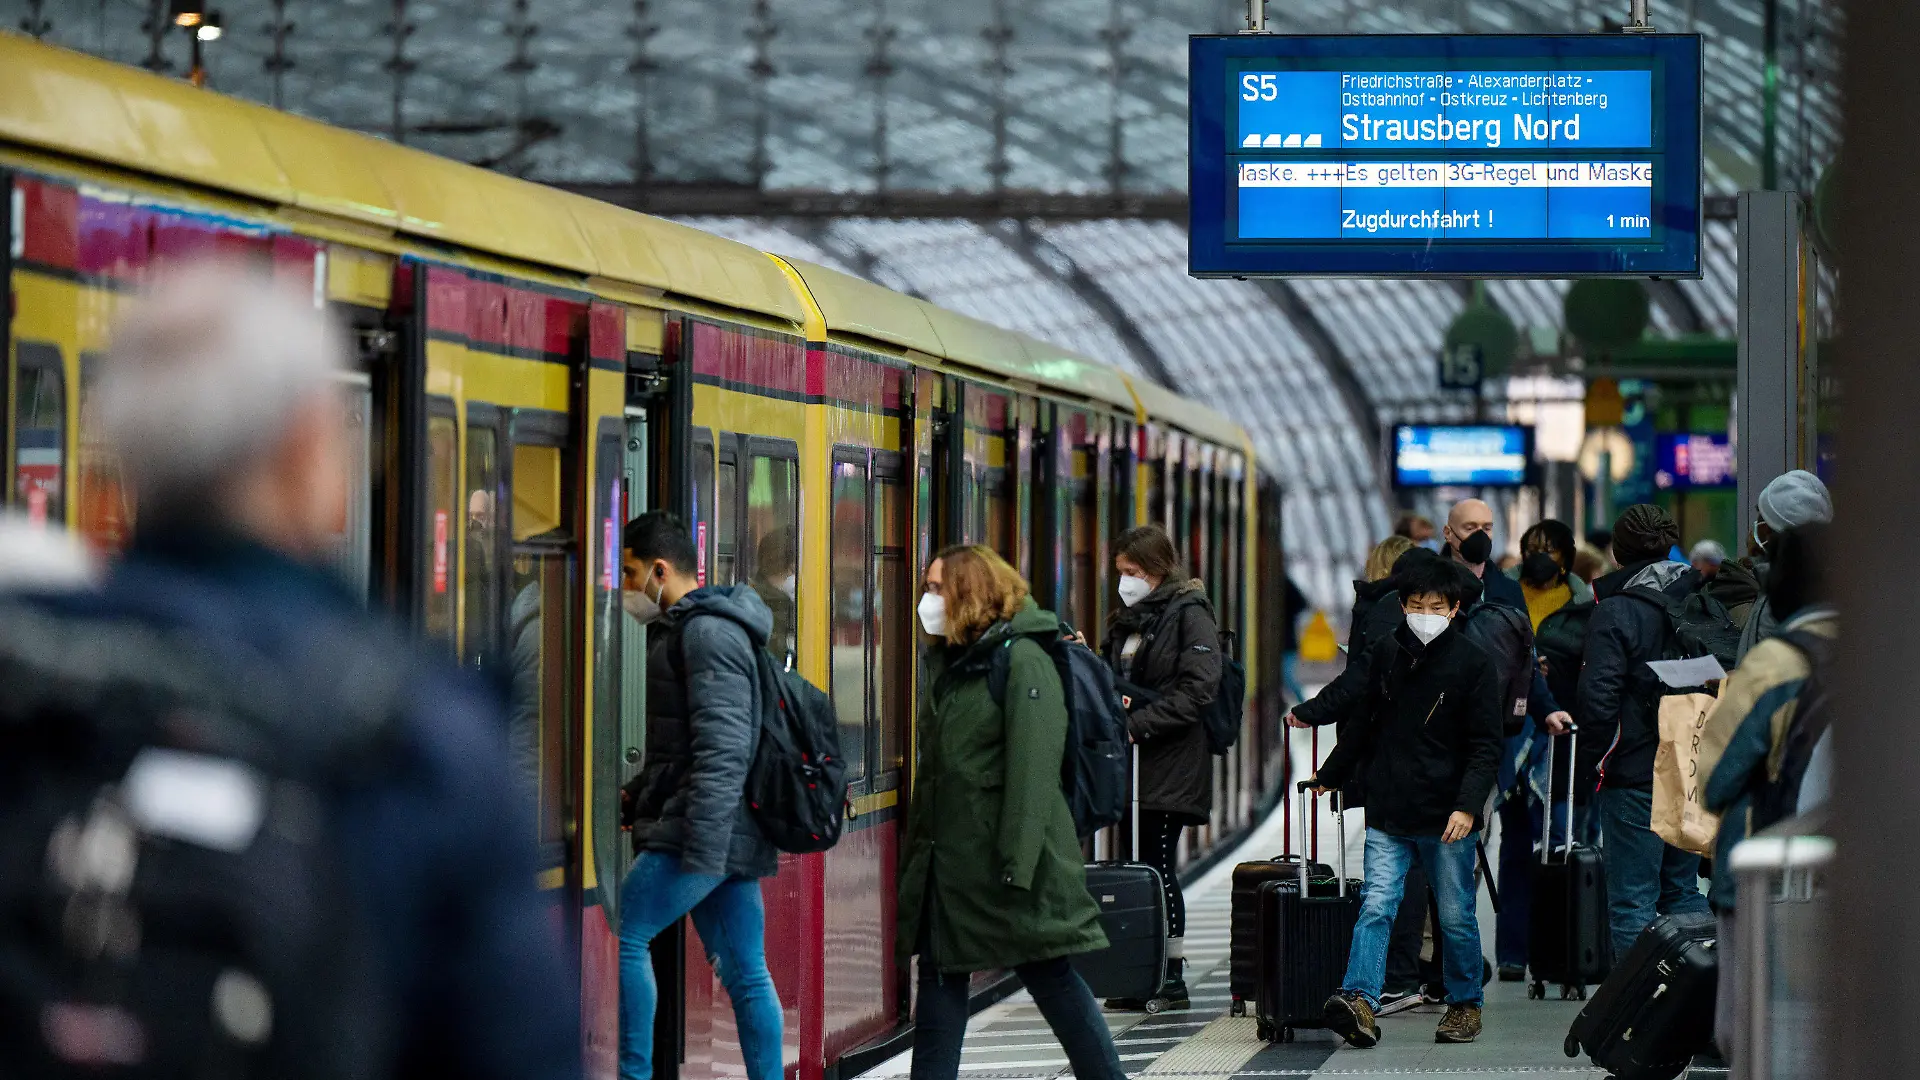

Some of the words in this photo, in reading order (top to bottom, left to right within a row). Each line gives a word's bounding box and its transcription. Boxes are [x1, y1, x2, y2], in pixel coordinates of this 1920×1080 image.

[1242, 74, 1278, 102] S5
[1342, 74, 1453, 89] Friedrichstraße
[1468, 74, 1582, 91] Alexanderplatz
[1342, 92, 1425, 106] Ostbahnhof
[1440, 92, 1508, 106] Ostkreuz
[1522, 92, 1608, 109] Lichtenberg
[1342, 113, 1500, 148] Strausberg
[1513, 113, 1580, 141] Nord
[1378, 163, 1438, 185] gelten
[1448, 163, 1537, 185] 3G-Regel
[1547, 163, 1579, 181] und
[1342, 209, 1480, 233] Zugdurchfahrt
[1606, 214, 1615, 228] 1
[1619, 214, 1651, 228] min
